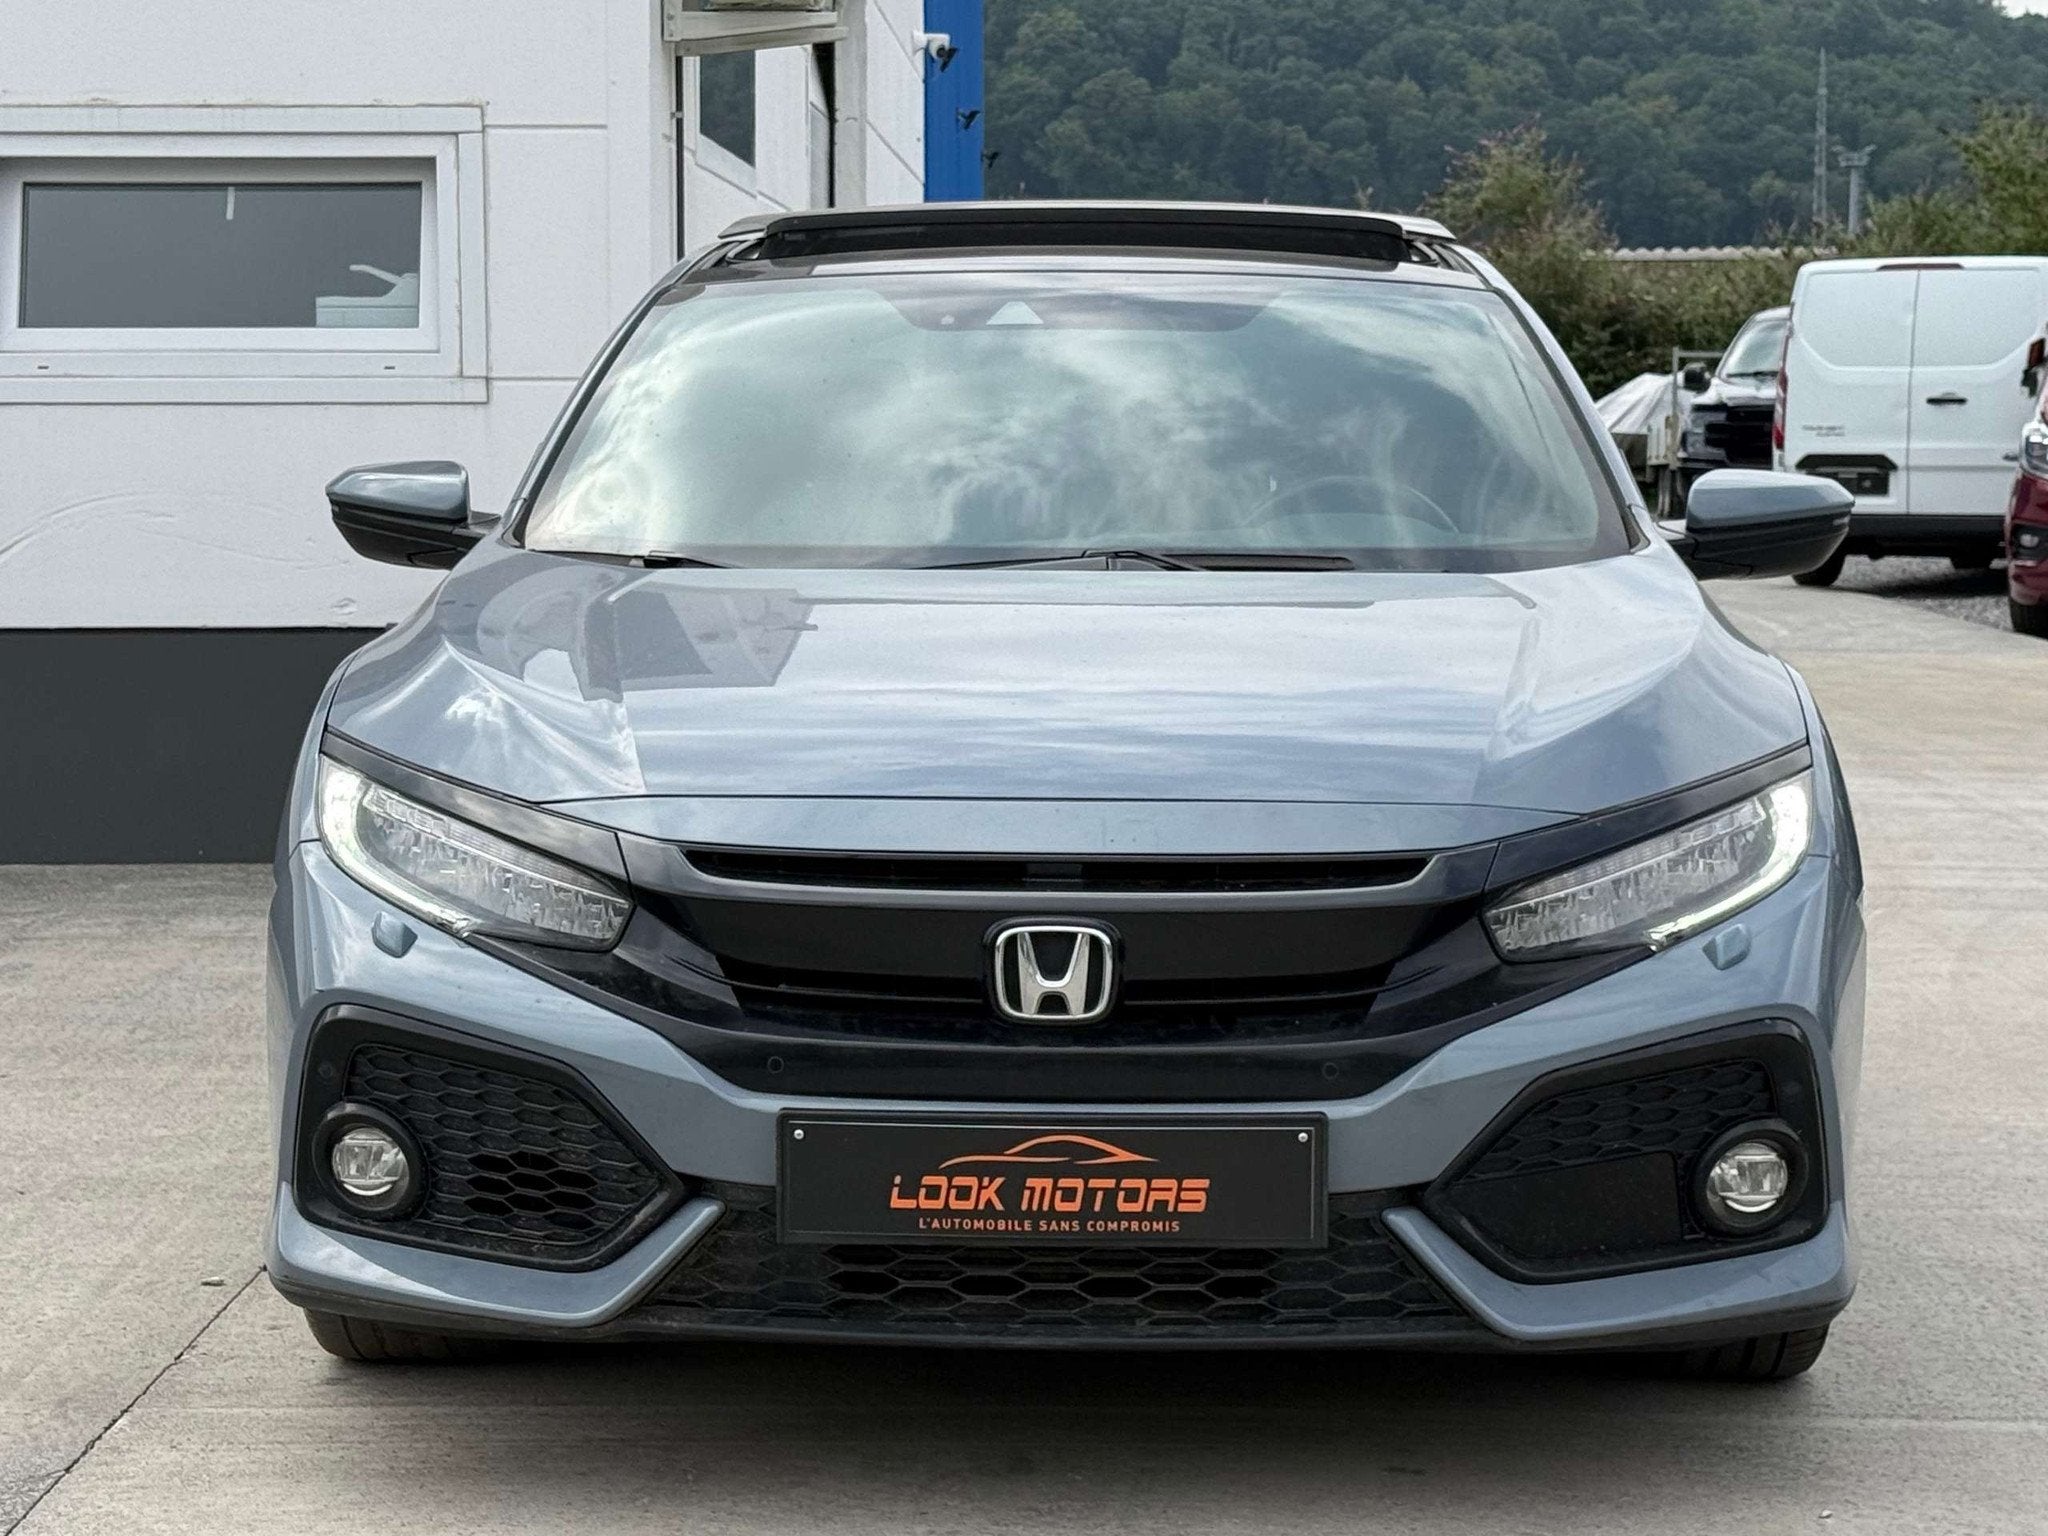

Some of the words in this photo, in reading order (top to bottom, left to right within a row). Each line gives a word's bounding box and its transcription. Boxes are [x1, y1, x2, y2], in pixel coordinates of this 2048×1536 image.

[890, 1175, 1005, 1211] LOOK
[1021, 1177, 1210, 1212] MOTORS
[918, 1217, 1032, 1231] L'AUTOMOBILE
[1039, 1220, 1080, 1231] SANS
[1087, 1220, 1180, 1232] COMPROMIS
